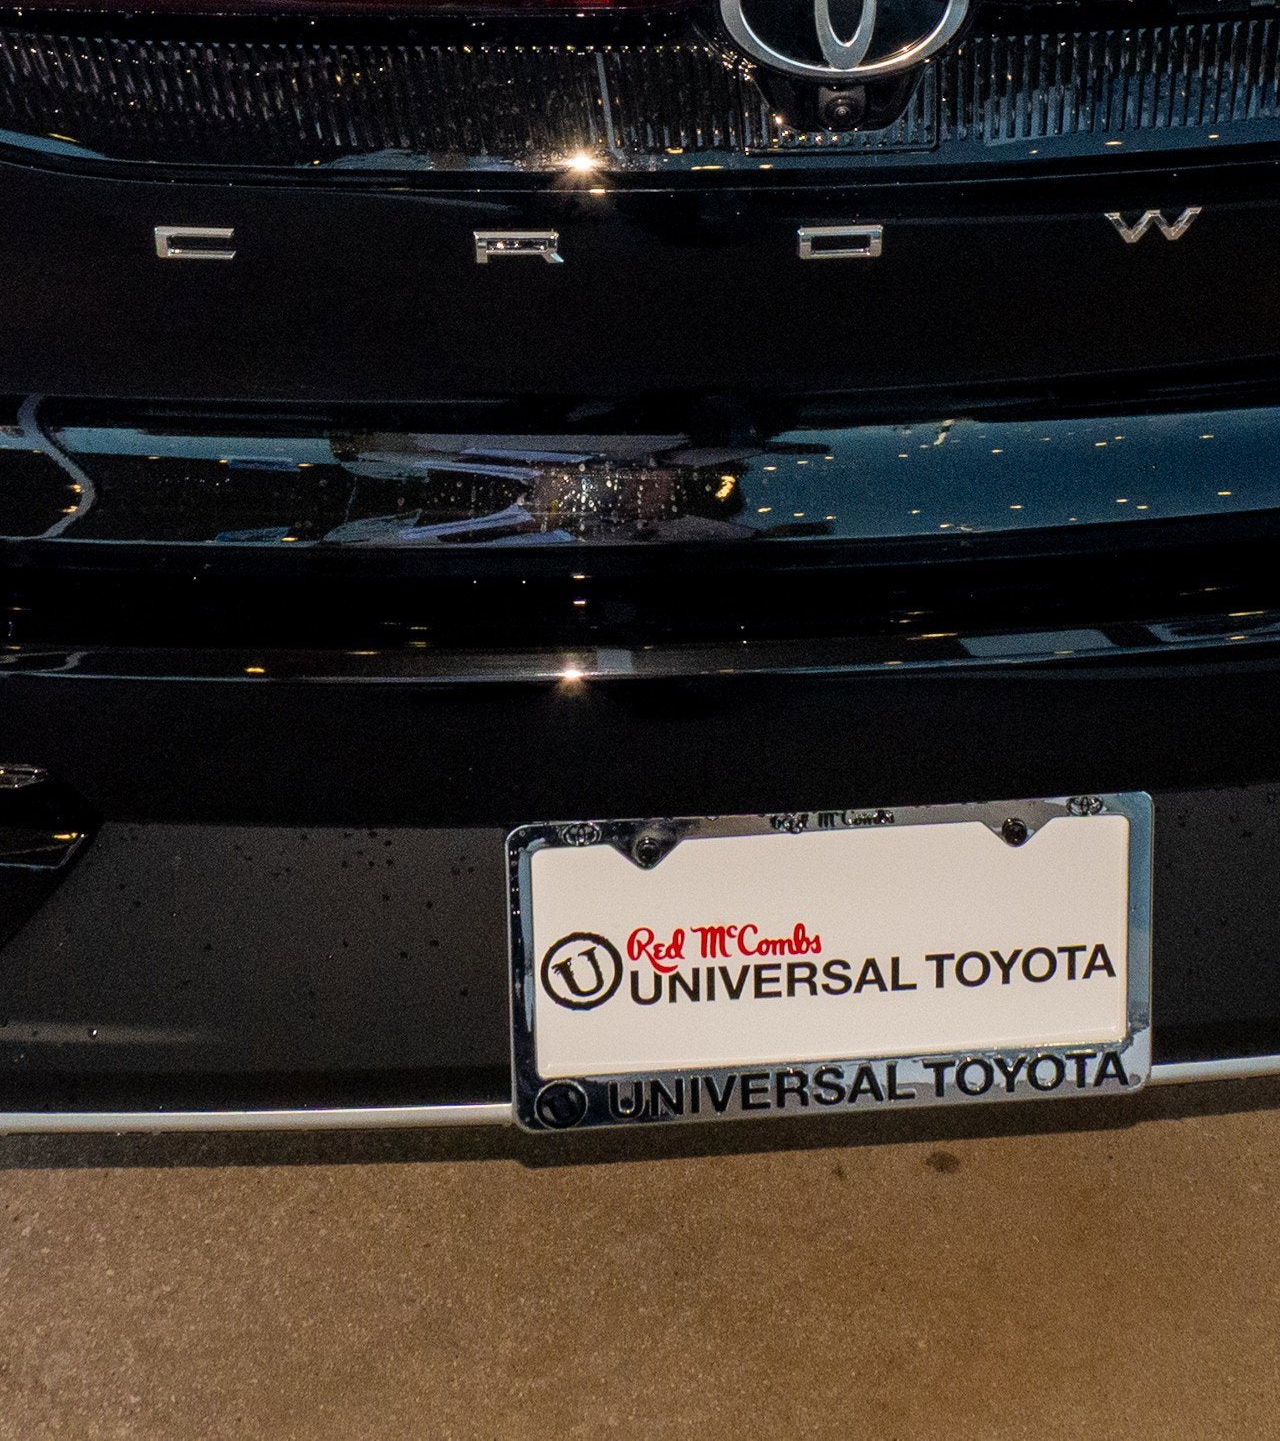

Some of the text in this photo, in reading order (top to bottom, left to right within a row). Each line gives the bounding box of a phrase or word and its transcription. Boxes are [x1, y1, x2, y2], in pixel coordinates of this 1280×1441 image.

[626, 922, 822, 974] Red McCombs
[630, 944, 1116, 1006] UNIVERSAL TOYOTA
[608, 1051, 1130, 1117] UNIVERSAL TOYOTA
